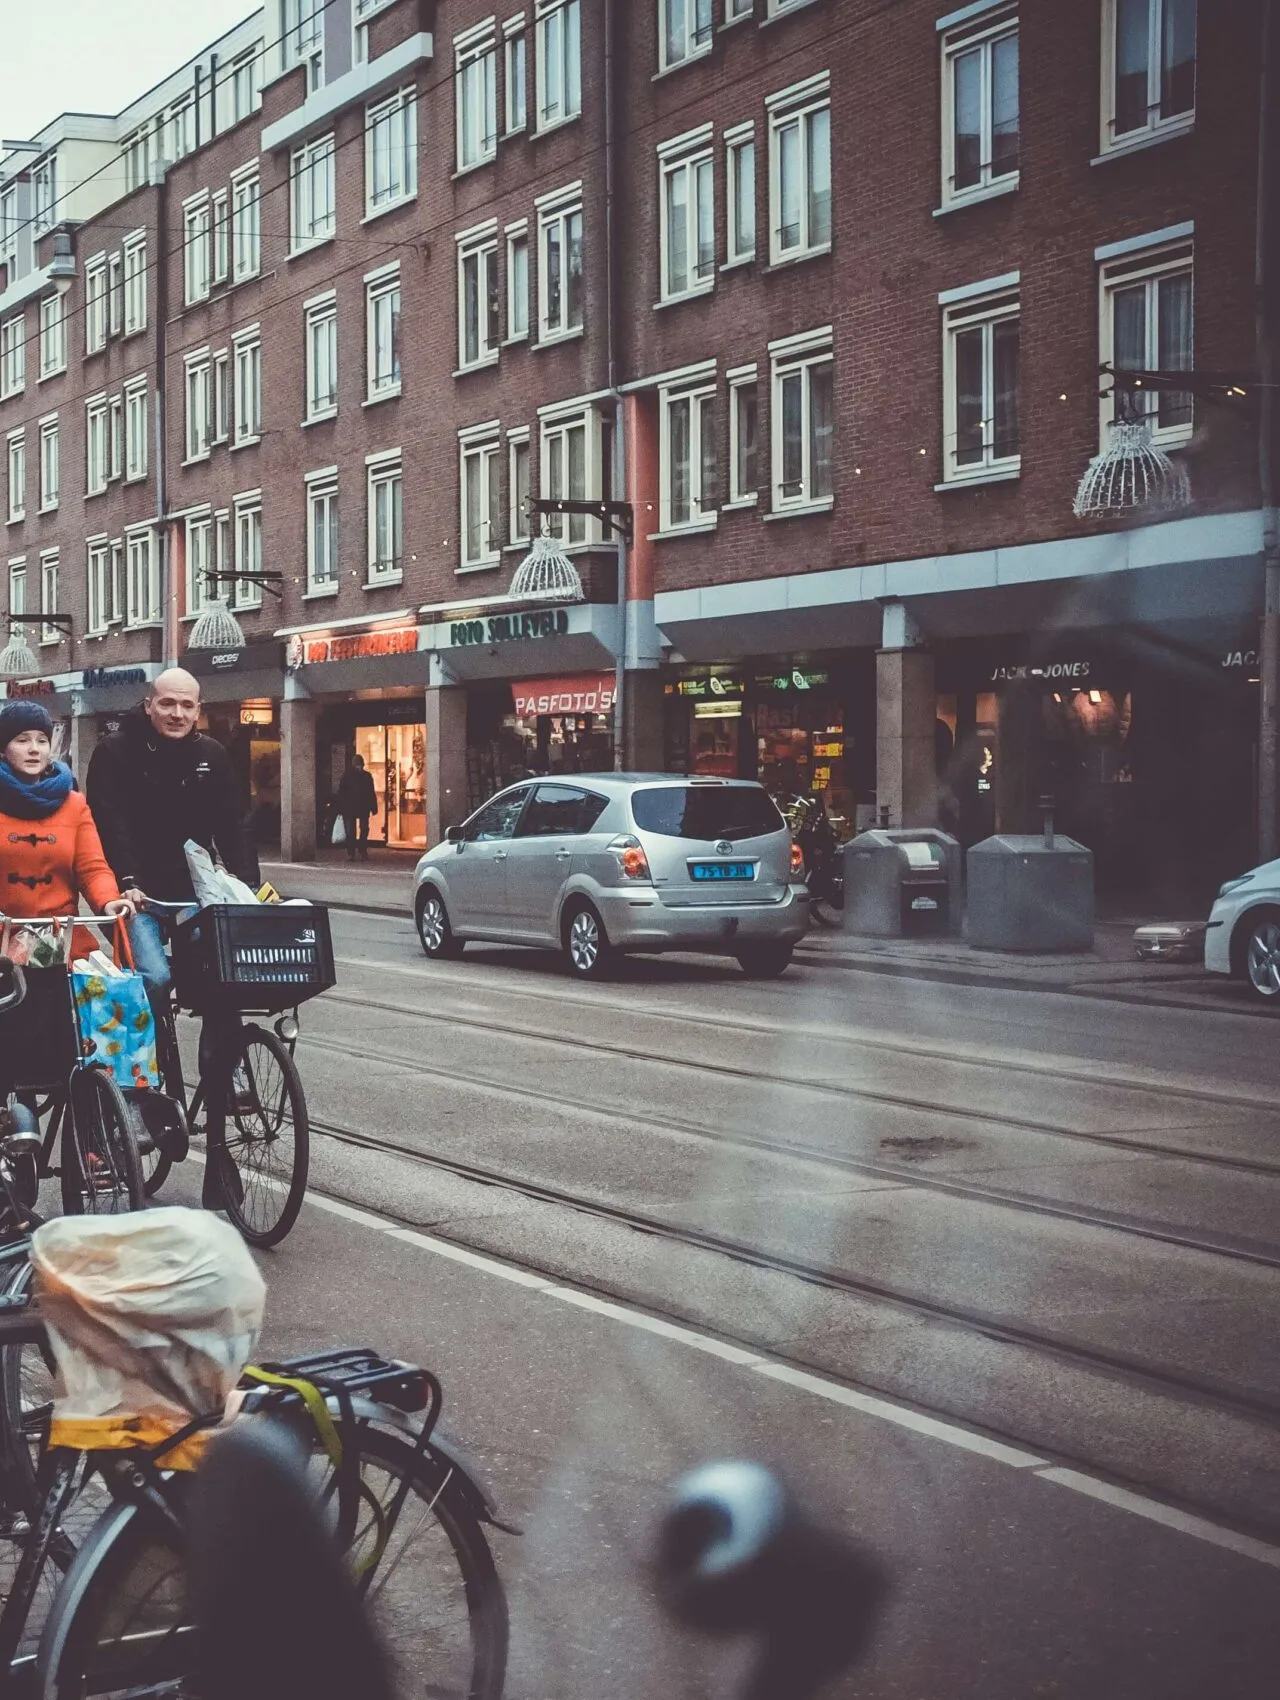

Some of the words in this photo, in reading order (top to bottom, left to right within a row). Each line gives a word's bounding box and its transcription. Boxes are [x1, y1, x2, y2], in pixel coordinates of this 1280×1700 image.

[450, 620, 485, 646] FOTO
[1042, 661, 1091, 678] JONES
[515, 680, 613, 715] PASFOTO'S
